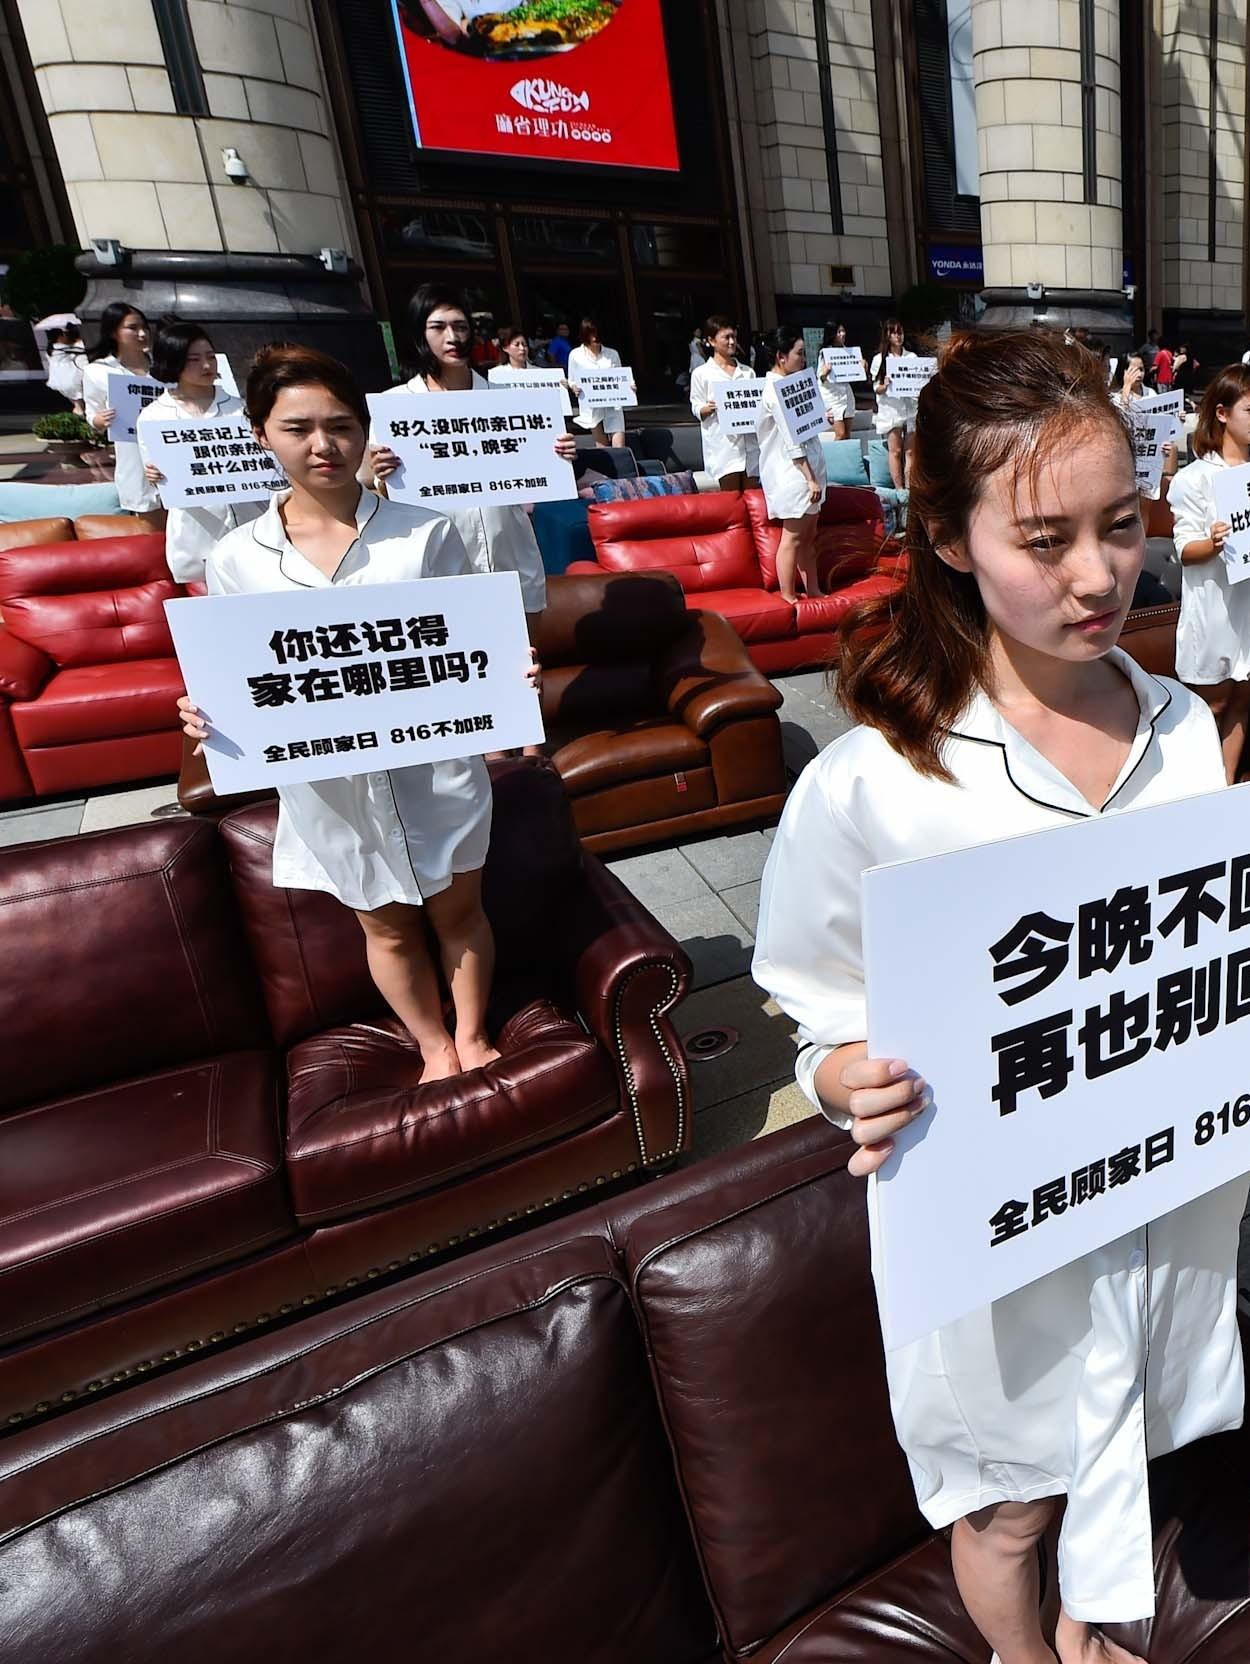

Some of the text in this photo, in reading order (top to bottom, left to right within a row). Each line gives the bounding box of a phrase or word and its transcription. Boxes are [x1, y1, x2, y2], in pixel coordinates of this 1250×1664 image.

[932, 260, 961, 269] YONDA
[727, 389, 763, 399] 我不是嫁
[724, 399, 760, 410] 只是嫁给
[161, 427, 252, 443] 已经忘记上
[193, 442, 266, 459] 跟你亲热
[190, 458, 277, 476] 是什么时候
[184, 484, 236, 496] 全民顾家日
[419, 477, 548, 497] 全民顾家日 816不加班
[269, 614, 449, 664] 你还记得
[263, 714, 494, 763] 全民顾家日 816不加班
[989, 1126, 1175, 1248] 全民顾家日
